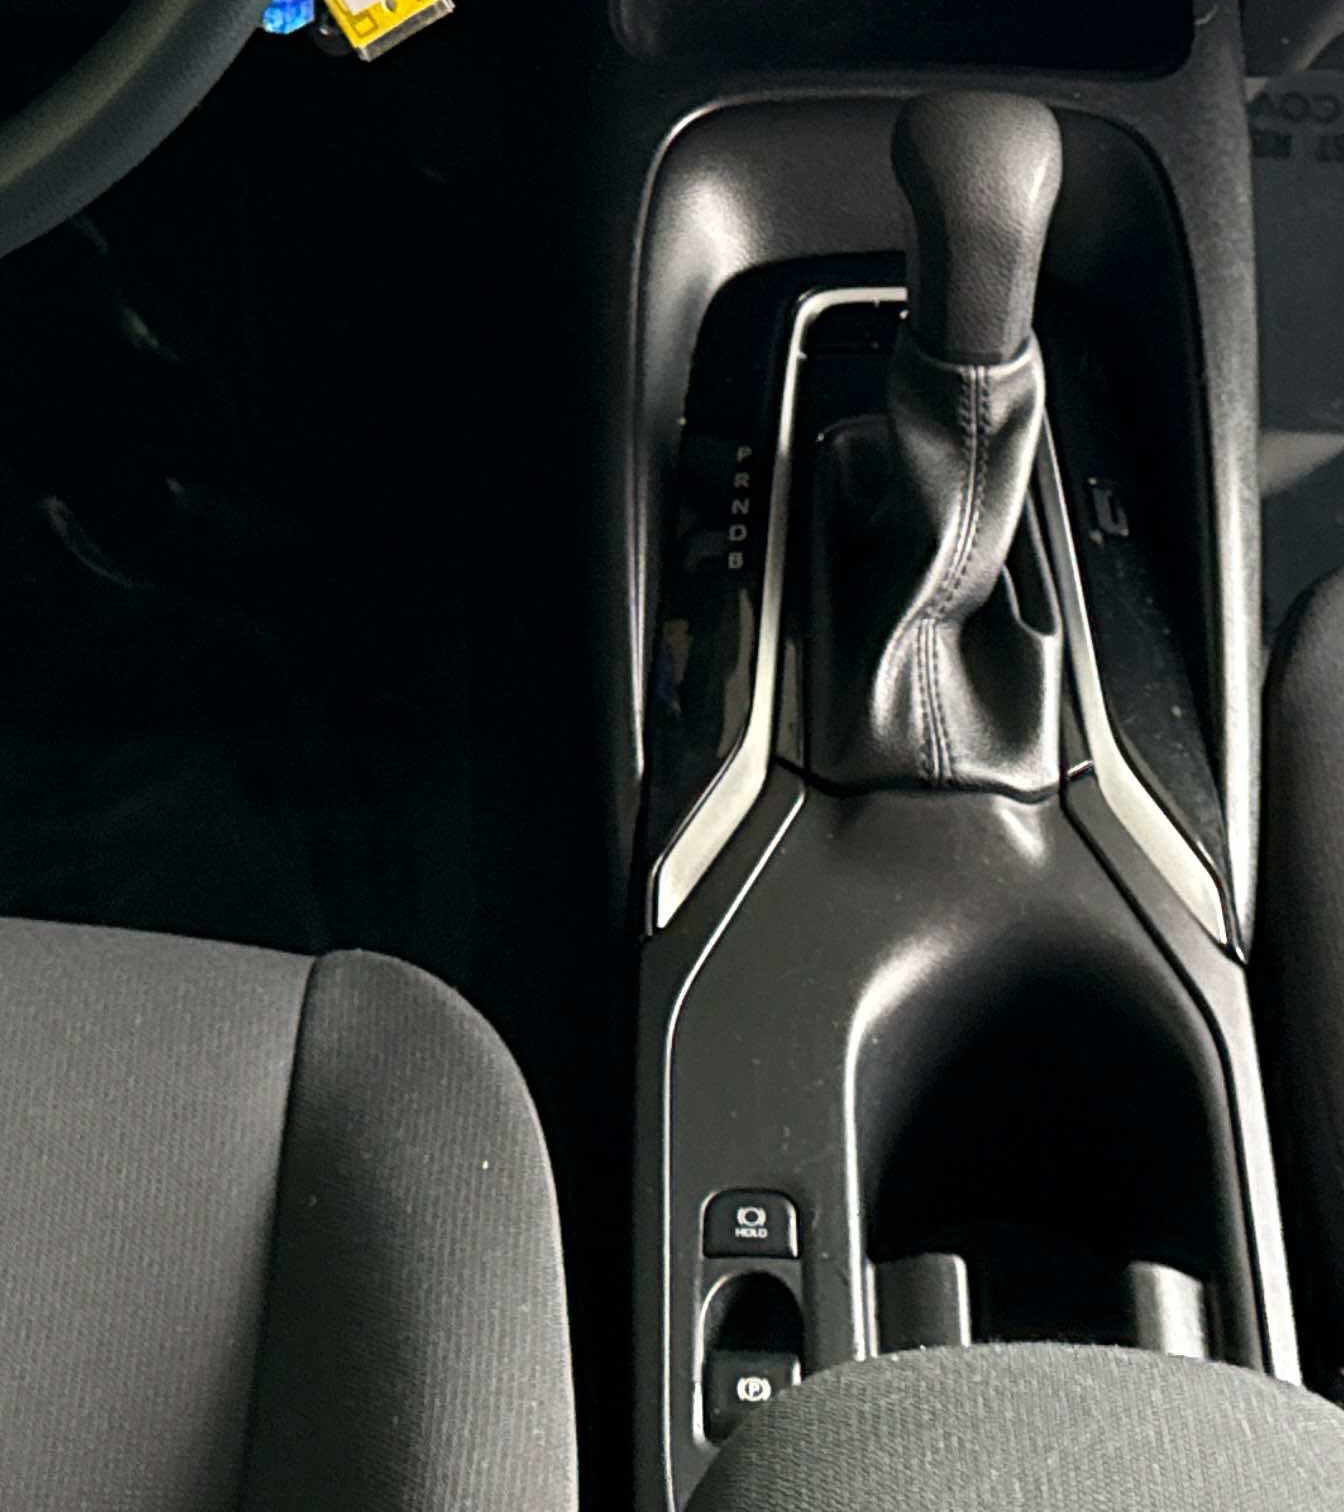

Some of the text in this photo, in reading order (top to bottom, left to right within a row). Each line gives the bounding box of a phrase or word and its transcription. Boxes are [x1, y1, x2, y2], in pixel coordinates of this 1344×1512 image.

[737, 445, 752, 462] P
[734, 472, 750, 488] R
[731, 497, 750, 515] N
[729, 524, 747, 541] D
[727, 551, 744, 569] B
[735, 1227, 768, 1239] HOLD
